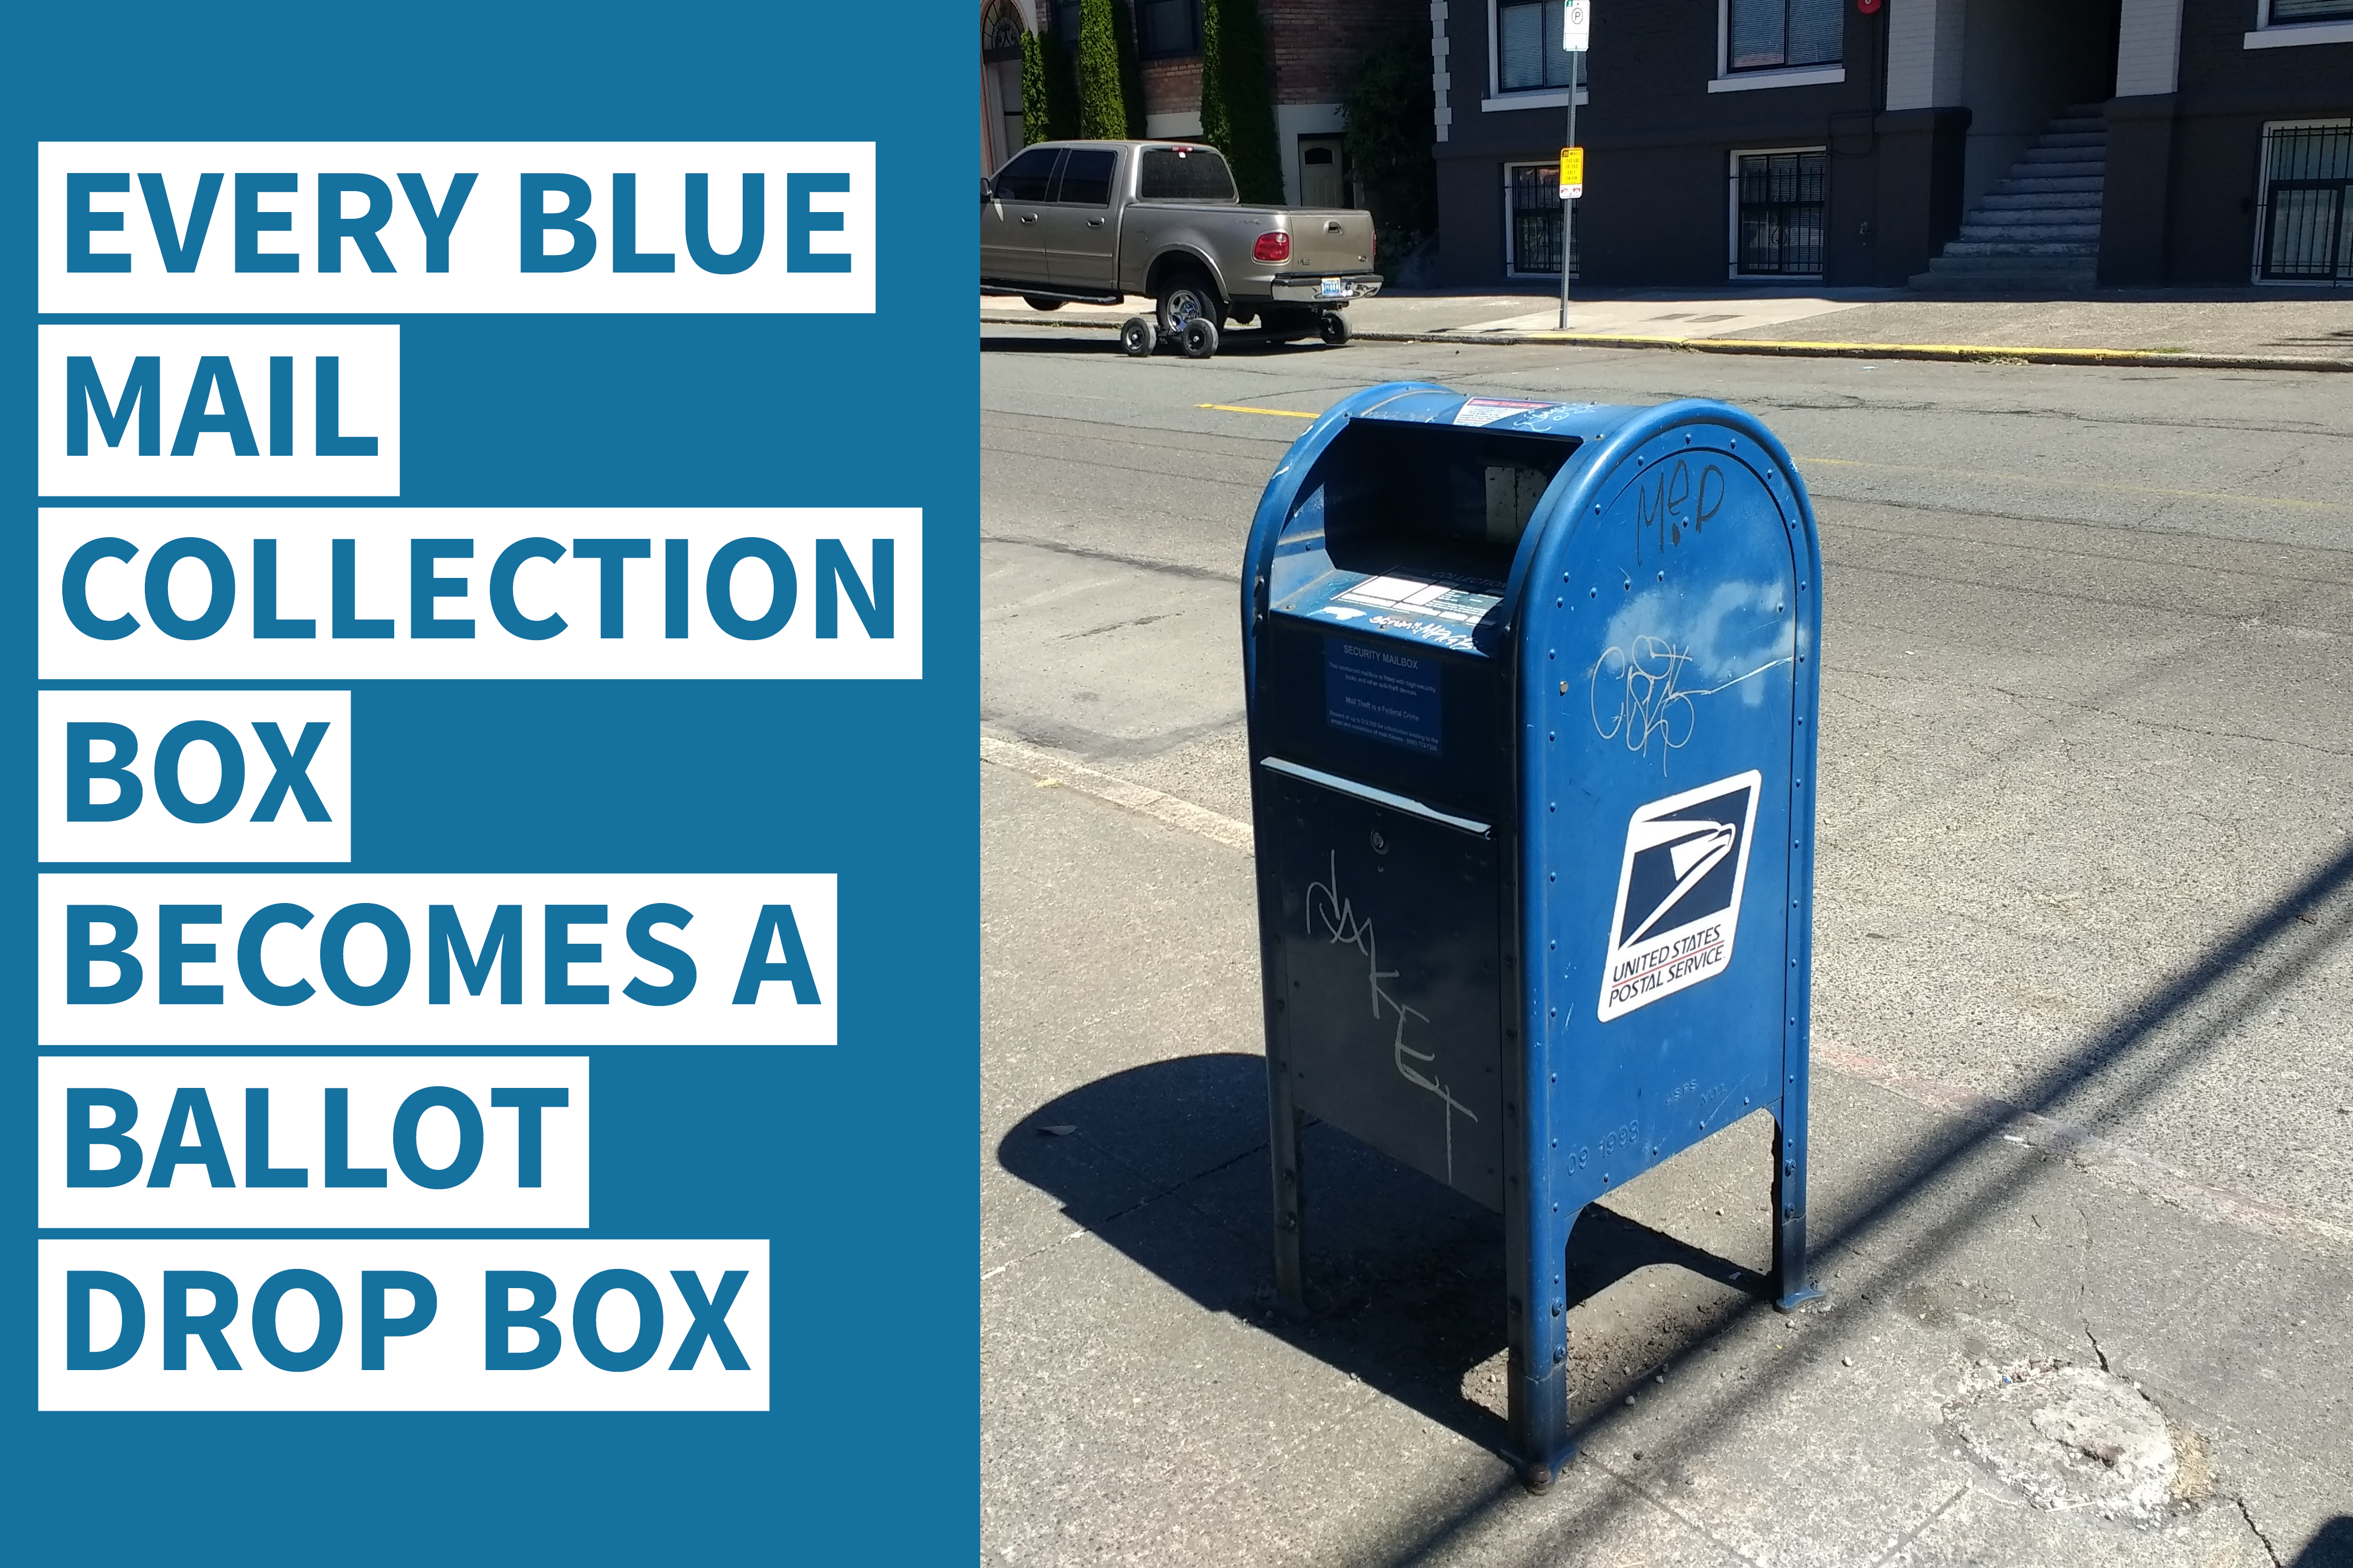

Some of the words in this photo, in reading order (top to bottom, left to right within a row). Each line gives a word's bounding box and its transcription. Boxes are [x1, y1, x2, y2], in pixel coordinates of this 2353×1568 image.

[1343, 645, 1381, 660] SECURITY
[1382, 653, 1419, 669] MAILBOX
[1406, 680, 1436, 693] high-security
[1346, 696, 1356, 705] Mail
[1357, 699, 1371, 709] Theft
[1382, 705, 1402, 716] Federal
[1403, 711, 1420, 722] Crime
[1613, 945, 1669, 982] UNITED
[1671, 924, 1721, 959] STATES
[1609, 970, 1664, 1008] POSTAL
[1667, 944, 1725, 983] SERVICE
[1567, 1146, 1590, 1177] 09
[1598, 1120, 1640, 1158] 1998
